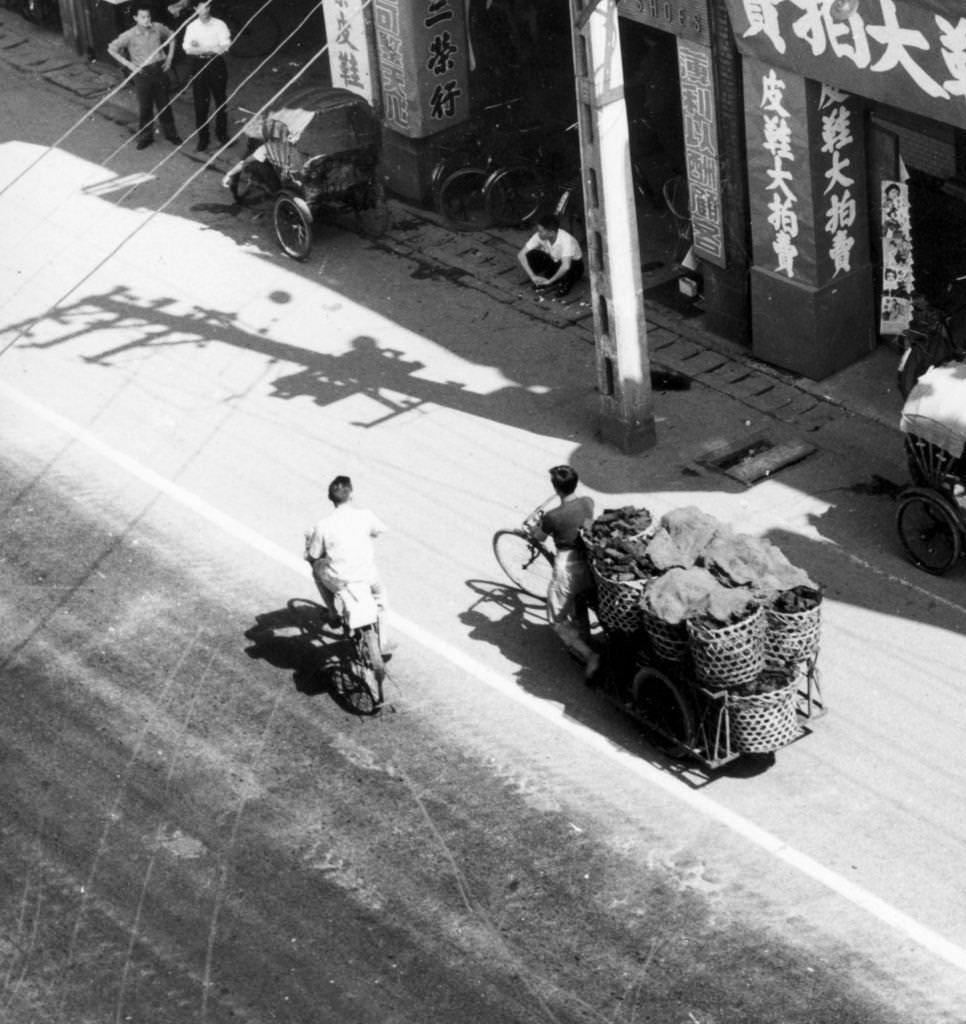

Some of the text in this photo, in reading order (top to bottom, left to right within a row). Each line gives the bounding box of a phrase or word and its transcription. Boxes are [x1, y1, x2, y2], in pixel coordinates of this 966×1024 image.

[760, 68, 799, 278] 皮鞋大拍賣
